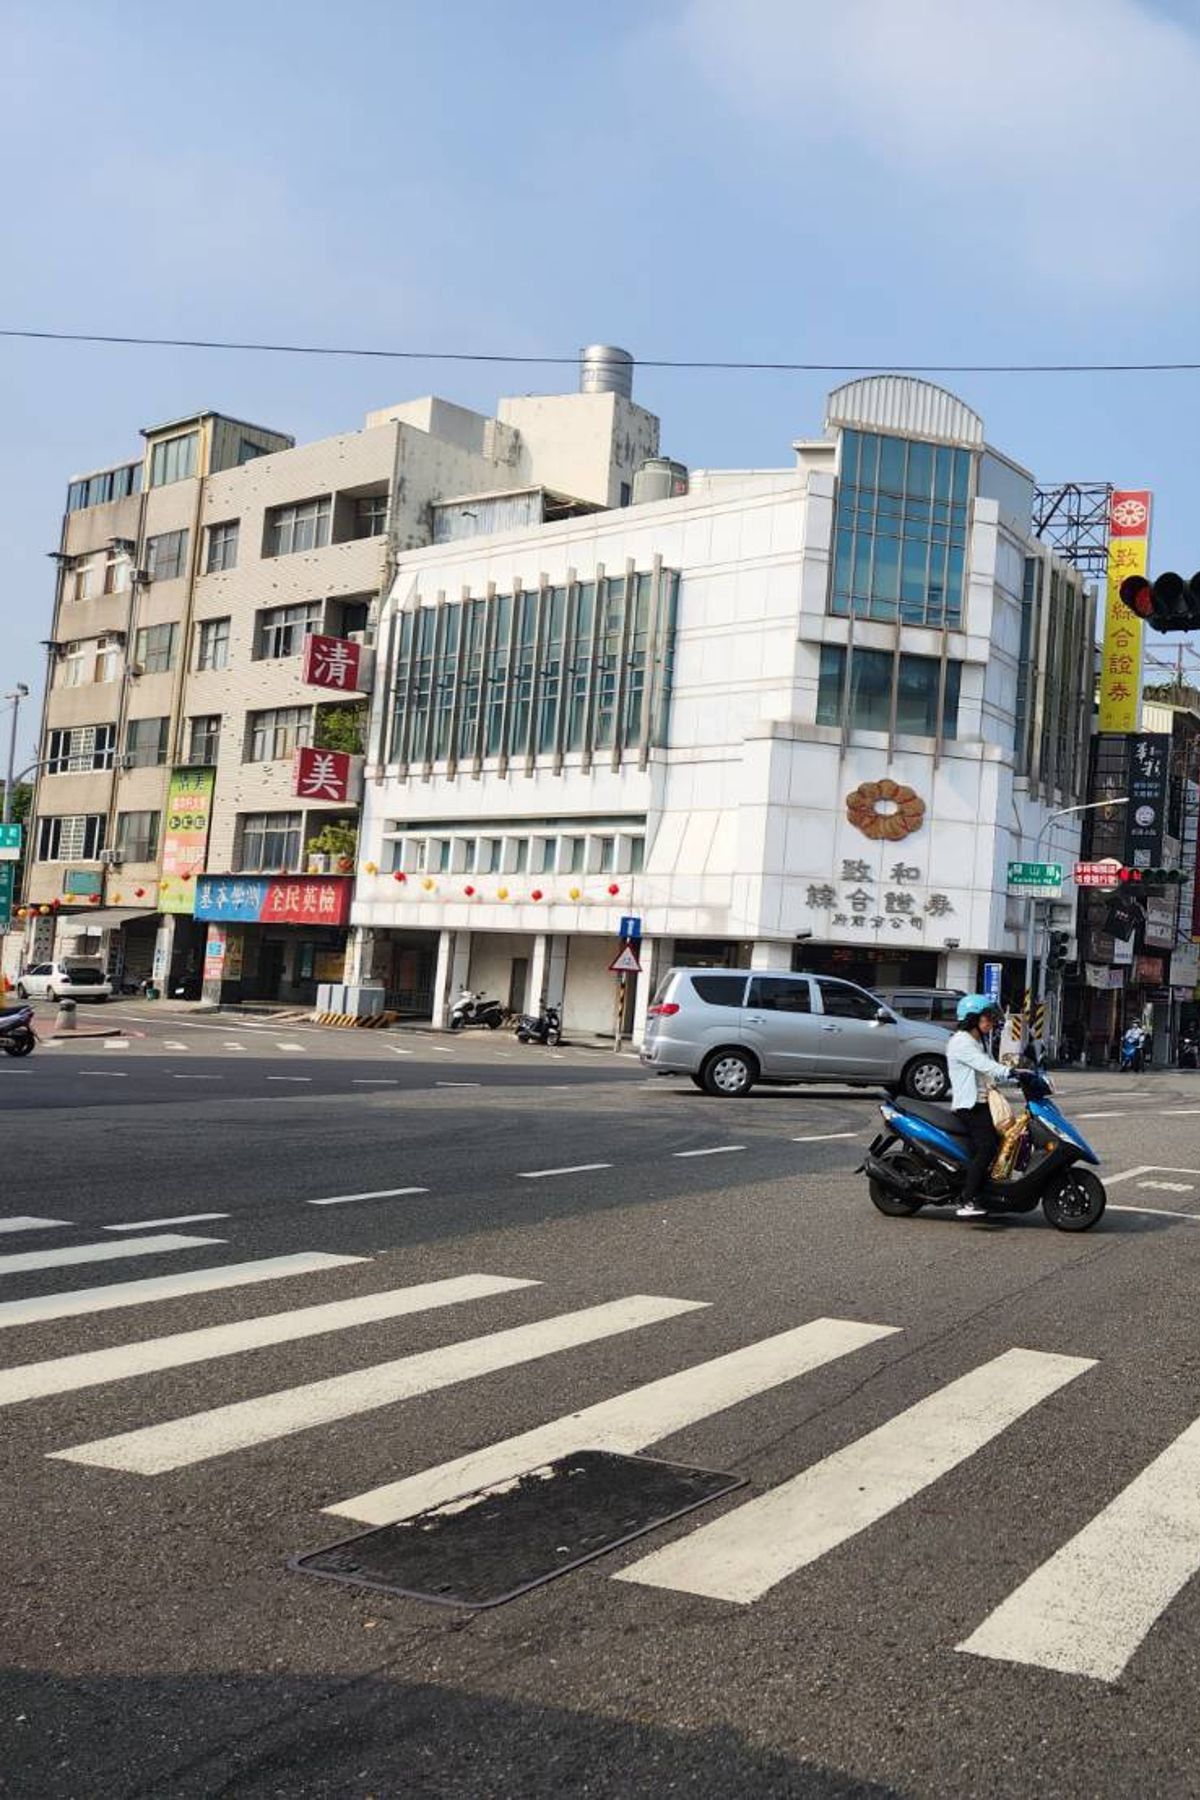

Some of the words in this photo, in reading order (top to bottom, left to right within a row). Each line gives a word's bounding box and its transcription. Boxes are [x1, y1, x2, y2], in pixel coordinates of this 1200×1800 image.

[314, 642, 356, 687] 清
[302, 753, 344, 800] 美
[841, 858, 922, 885] 致和
[271, 884, 336, 913] 全民英檢
[805, 884, 954, 916] 綜合證券
